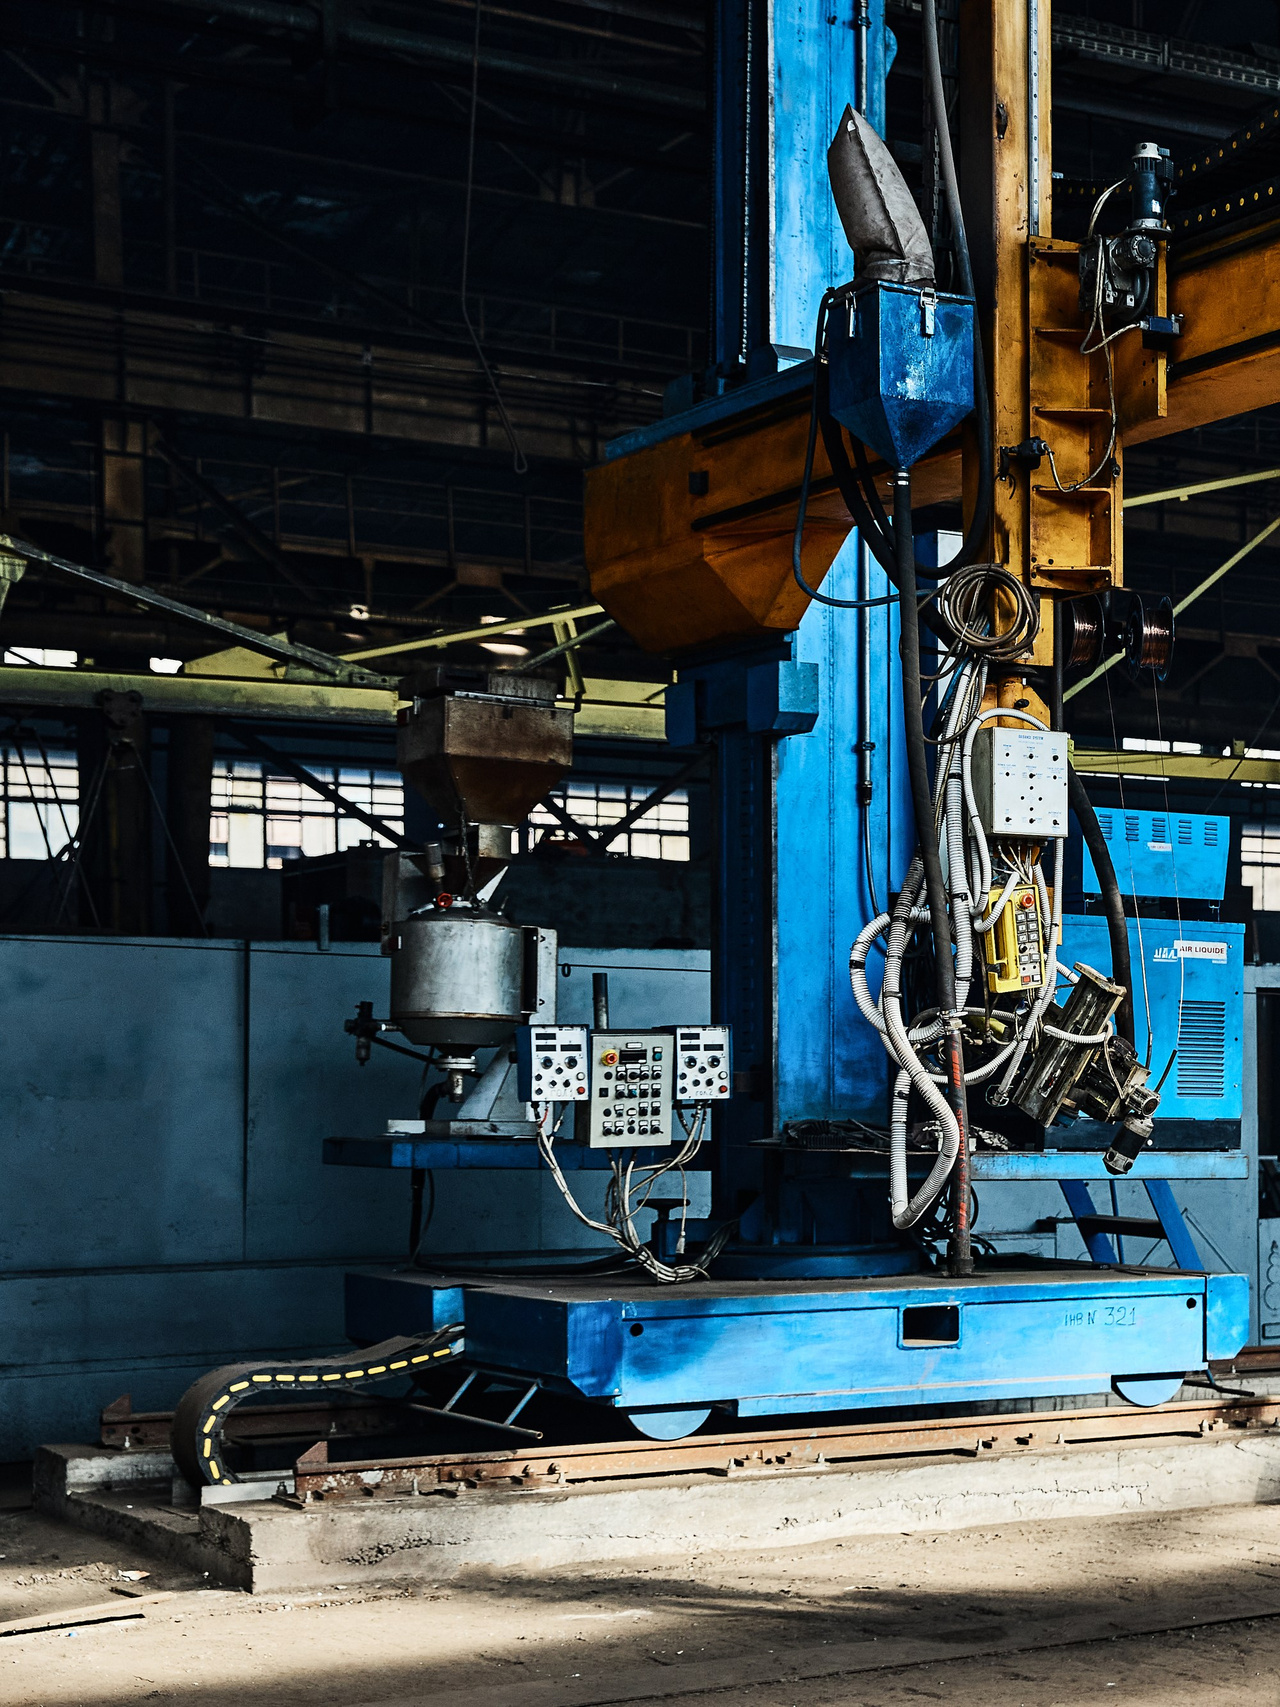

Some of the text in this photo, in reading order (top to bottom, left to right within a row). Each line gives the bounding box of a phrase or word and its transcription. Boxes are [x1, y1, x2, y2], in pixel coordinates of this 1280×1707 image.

[1180, 945, 1225, 955] AIR LIQUIDE
[1104, 1306, 1136, 1326] 321
